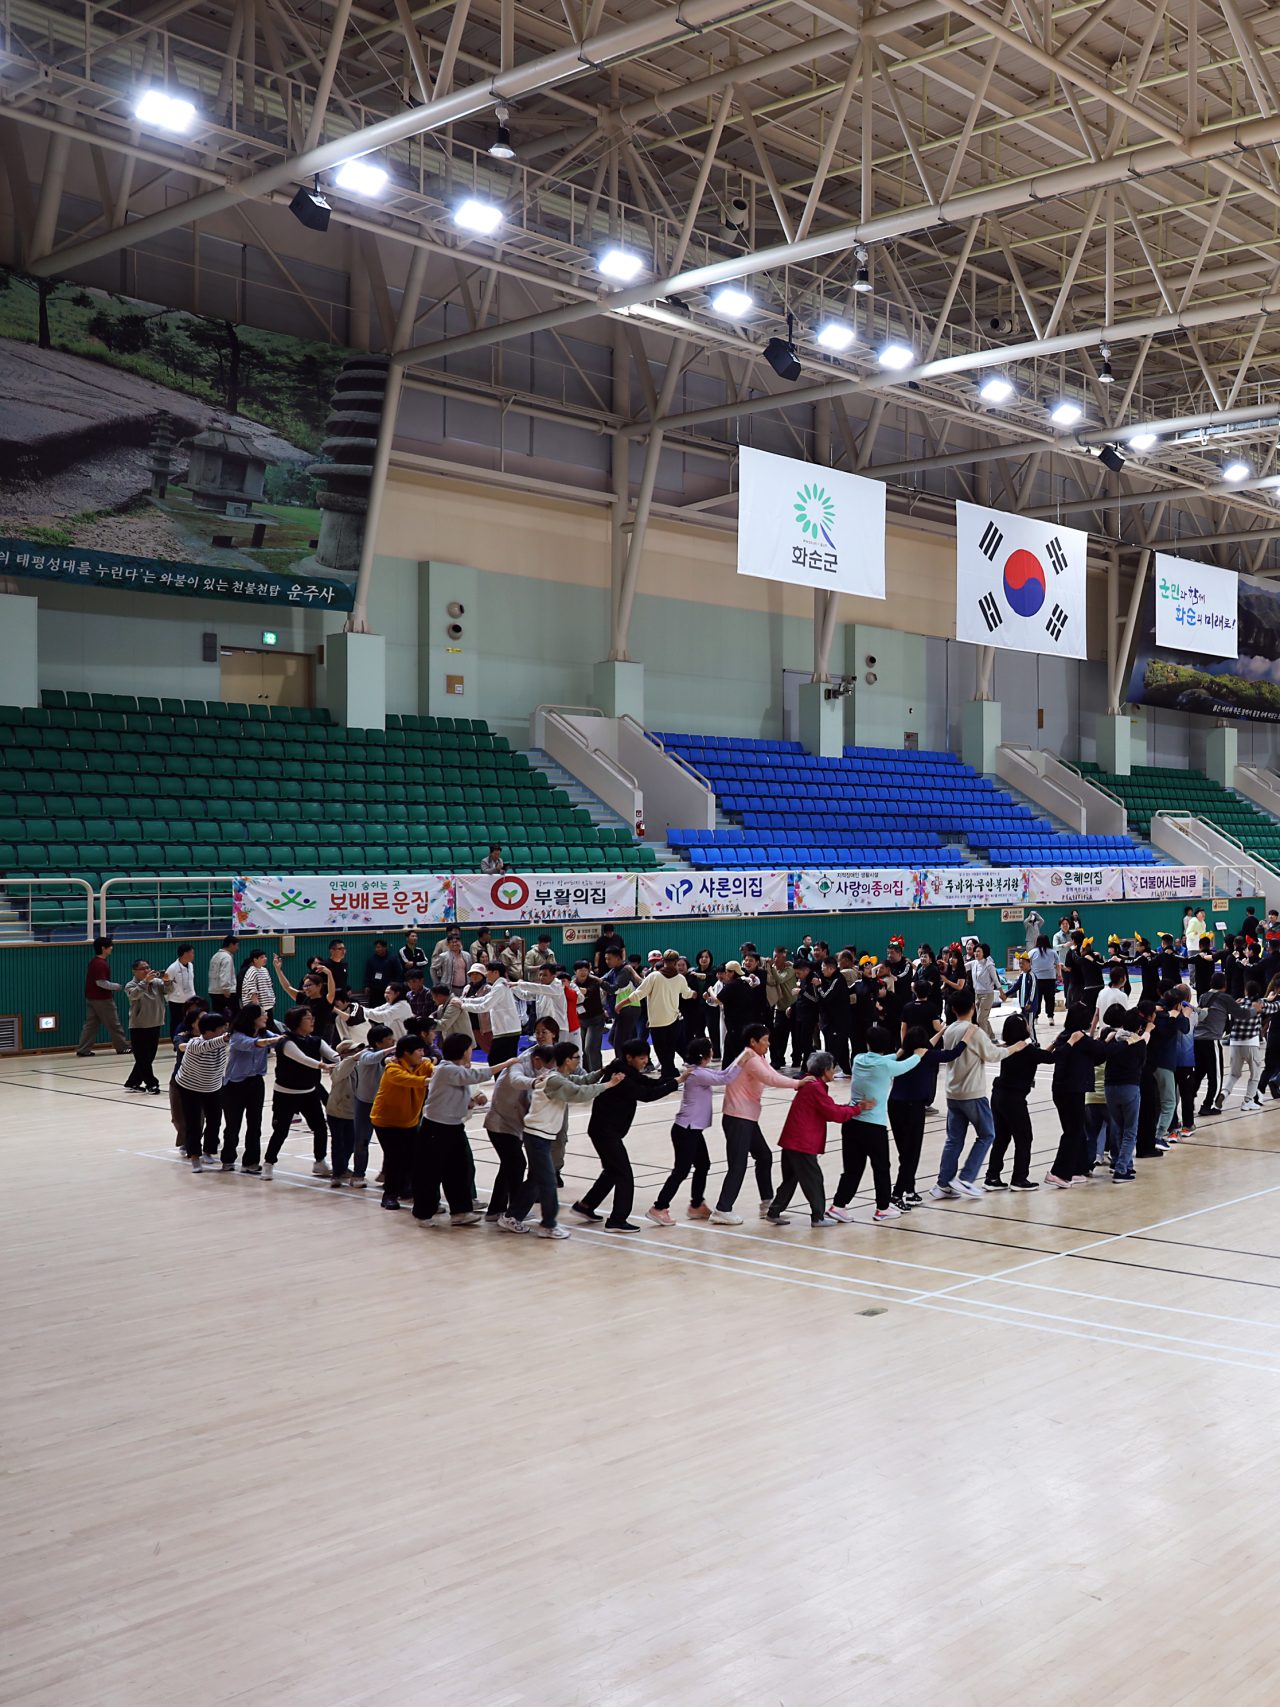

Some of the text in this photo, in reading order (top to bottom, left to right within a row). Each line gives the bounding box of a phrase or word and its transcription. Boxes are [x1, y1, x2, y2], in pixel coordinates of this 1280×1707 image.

[791, 545, 838, 573] 화순군
[16, 553, 92, 576] 태평성대를
[159, 572, 199, 588] 와불이
[203, 577, 229, 592] 있는
[231, 580, 281, 597] 천불천탑
[287, 584, 335, 604] 운주사
[1159, 578, 1206, 605] 군민과 함께
[1175, 604, 1236, 630] 화순의 미래로!
[329, 880, 357, 891] 인권이
[392, 880, 400, 891] 곳
[699, 877, 763, 899] 샤론의집
[835, 880, 903, 898] 사랑의종의집
[1063, 871, 1103, 886] 은혜의집
[1139, 875, 1197, 889] 더불어사는마을
[328, 890, 429, 915] 보배로운집
[534, 888, 606, 906] 부활의집
